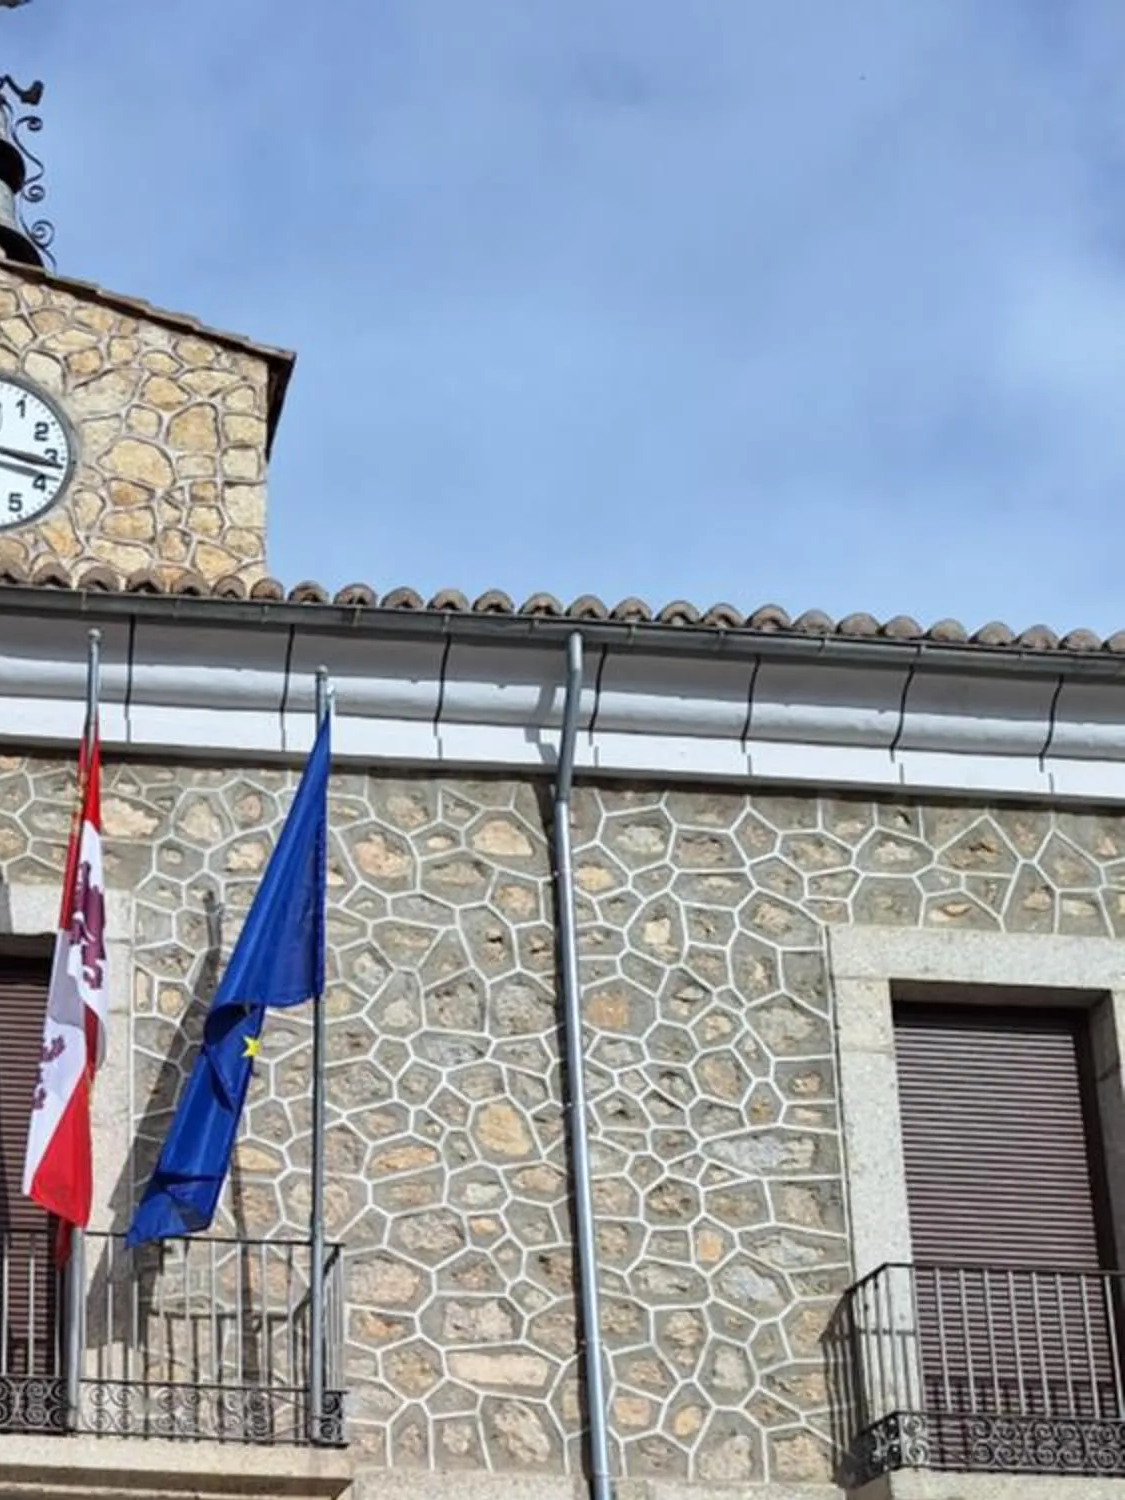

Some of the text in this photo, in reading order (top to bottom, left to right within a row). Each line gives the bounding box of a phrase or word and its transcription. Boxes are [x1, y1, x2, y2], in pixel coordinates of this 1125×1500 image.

[16, 399, 26, 418] 1
[34, 422, 50, 441] 2
[45, 448, 60, 467] 3
[32, 474, 48, 492] 4
[8, 493, 23, 512] 5
